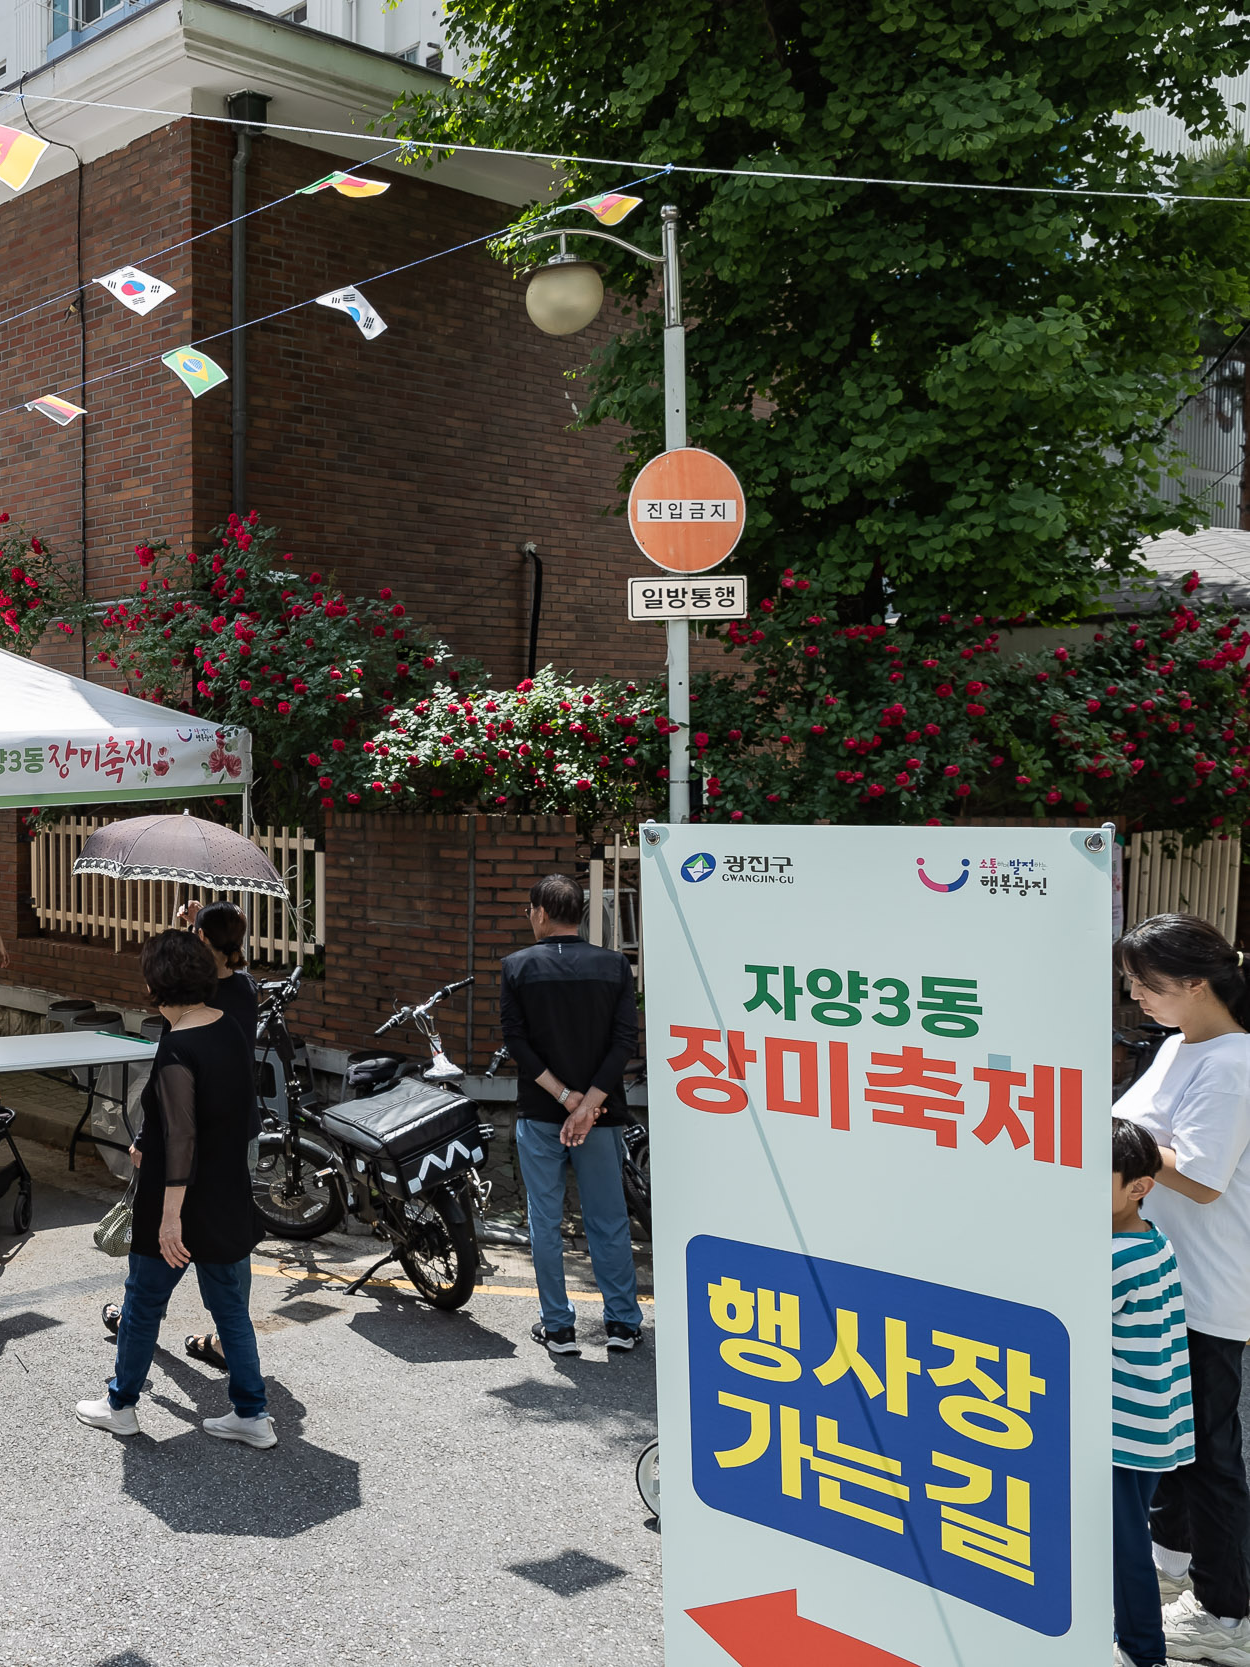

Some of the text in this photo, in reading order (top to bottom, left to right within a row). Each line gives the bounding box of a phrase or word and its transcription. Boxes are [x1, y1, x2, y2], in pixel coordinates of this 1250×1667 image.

[647, 502, 726, 520] 진입금지
[642, 586, 735, 610] 일방통행
[48, 736, 152, 783] 장미축제
[723, 856, 793, 873] 광진구
[722, 874, 794, 884] GWANGJIN-GU
[980, 874, 1047, 896] 행복광진
[743, 964, 983, 1038] 자양3동
[666, 1025, 1083, 1169] 장미축제
[707, 1276, 1046, 1450] 행사장
